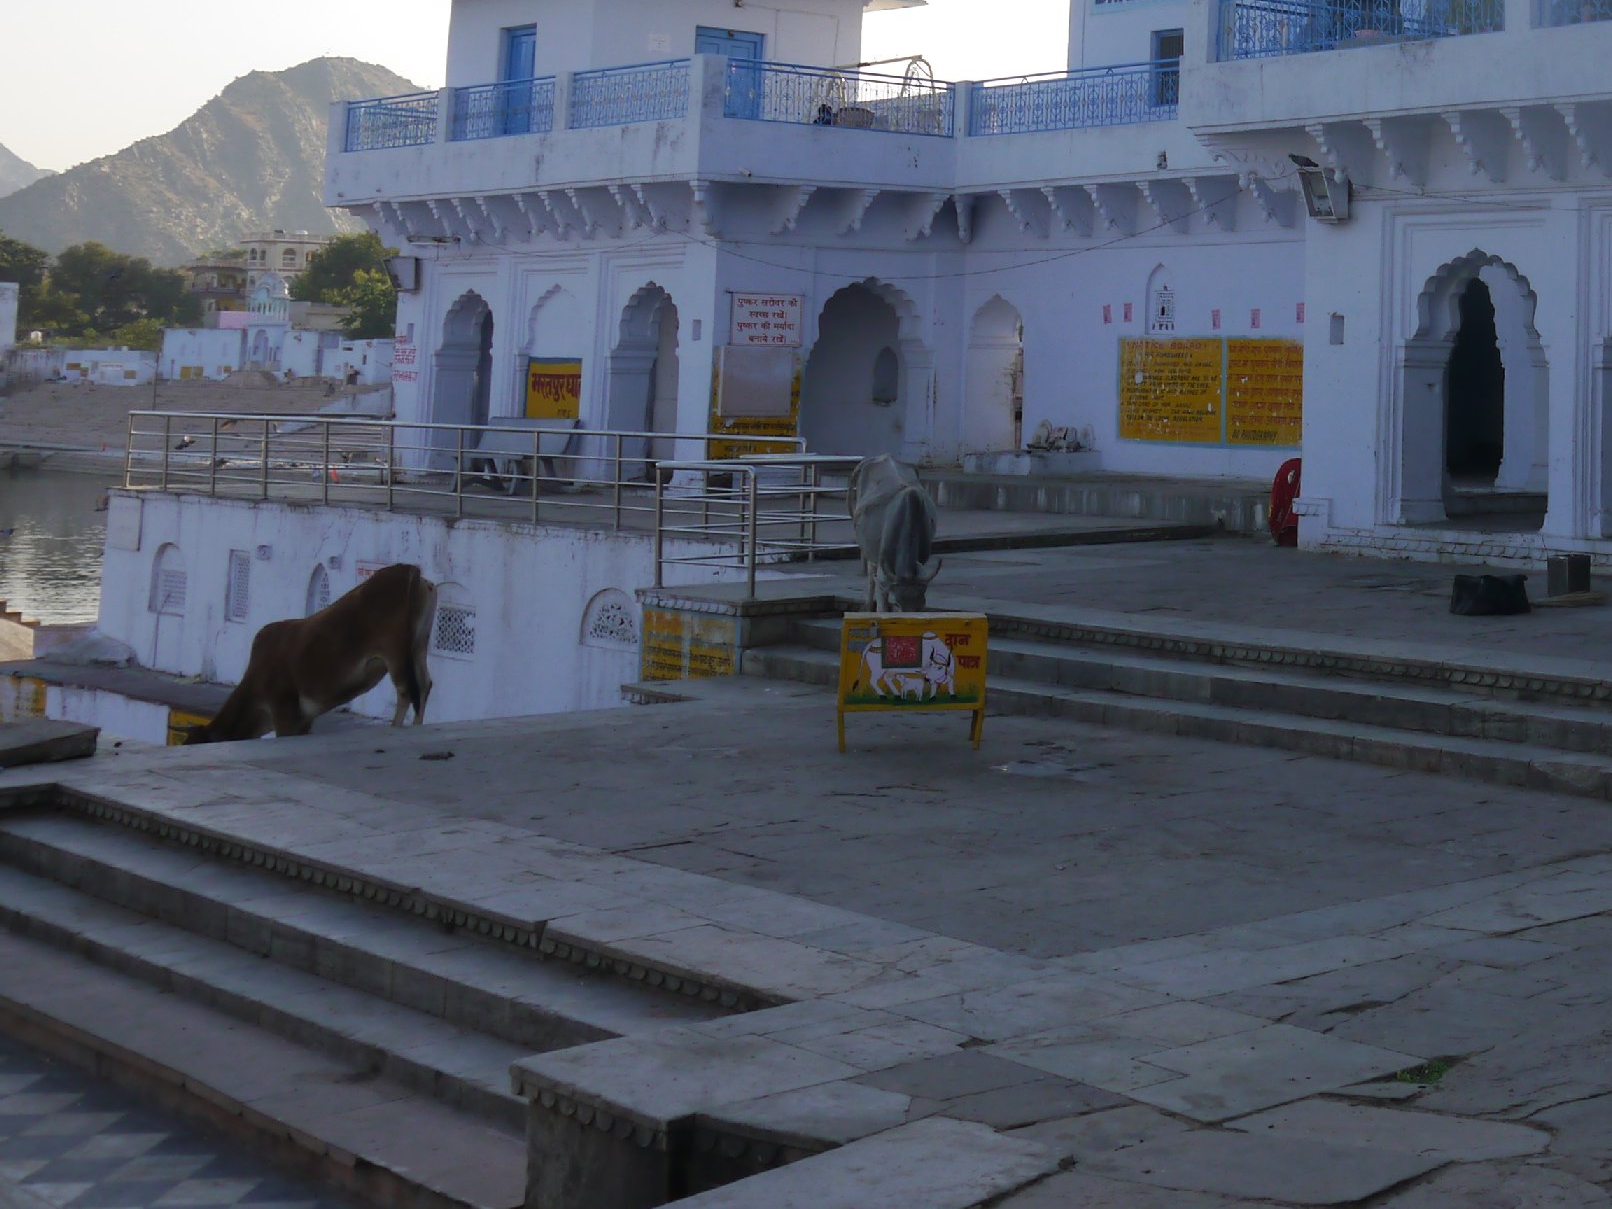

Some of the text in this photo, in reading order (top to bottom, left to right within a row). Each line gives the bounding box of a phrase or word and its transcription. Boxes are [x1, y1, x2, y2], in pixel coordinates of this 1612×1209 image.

[736, 321, 758, 332] पुष्कर
[531, 372, 566, 403] भरतपुर
[944, 633, 972, 653] दान
[956, 655, 982, 670] पात्र
